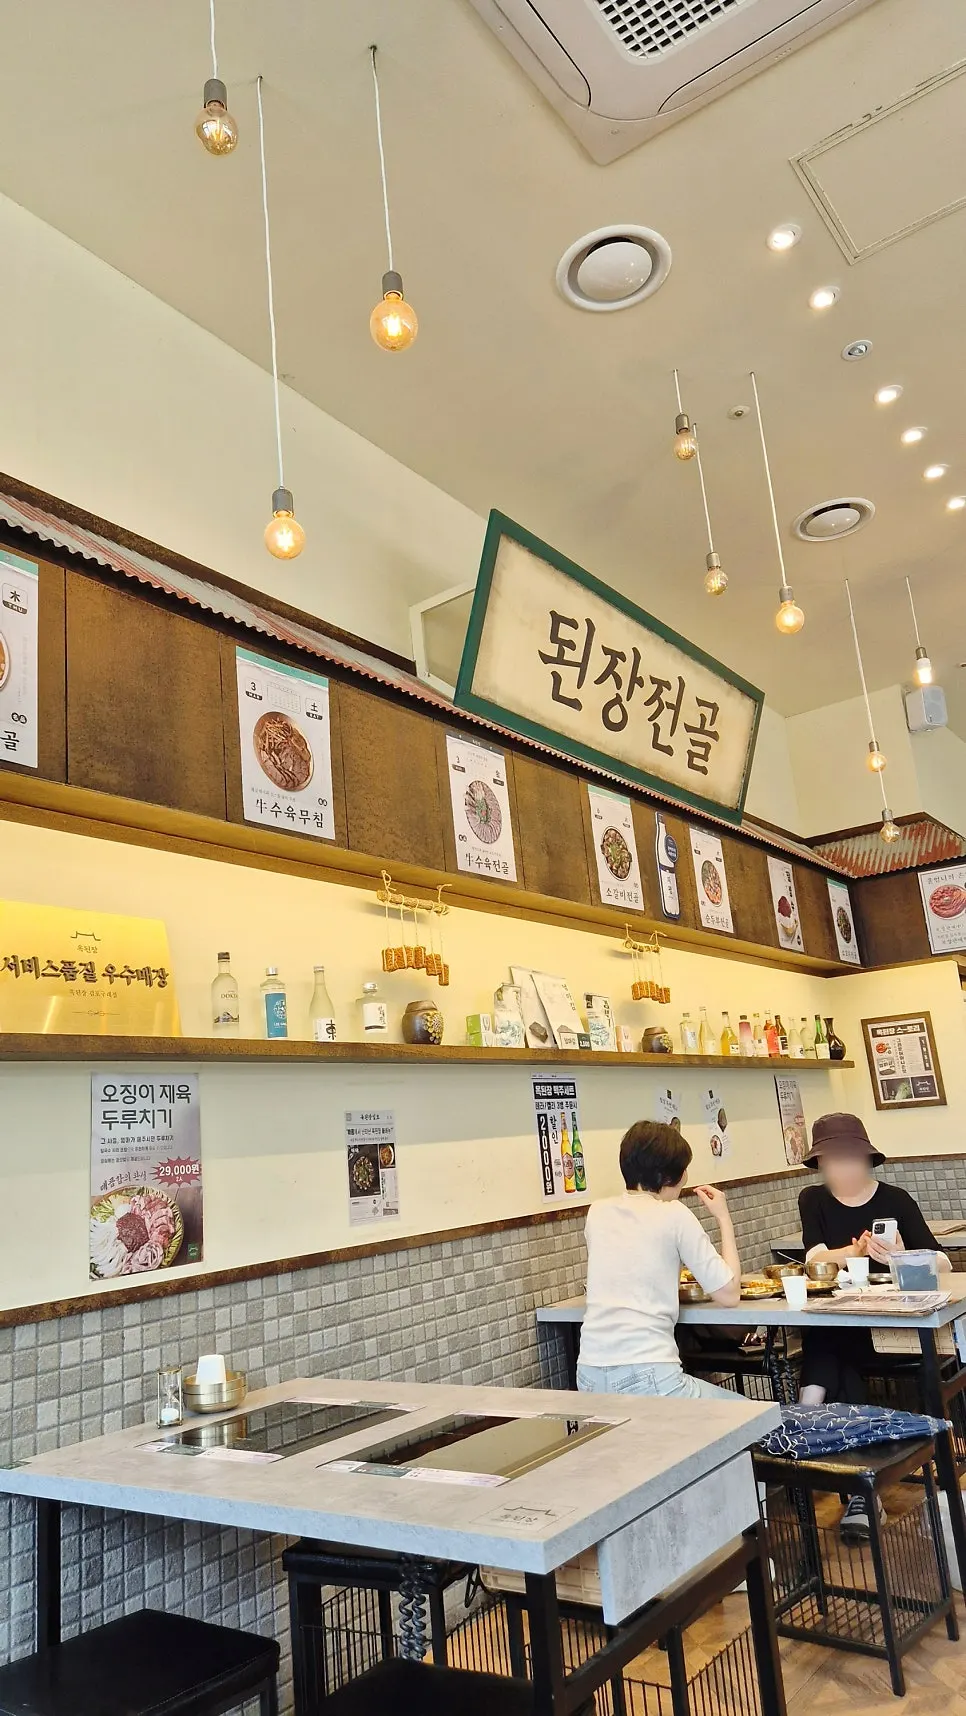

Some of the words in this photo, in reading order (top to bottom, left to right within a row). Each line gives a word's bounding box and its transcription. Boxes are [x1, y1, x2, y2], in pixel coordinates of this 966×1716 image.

[250, 682, 257, 691] 3
[538, 610, 720, 775] 된장전골
[0, 954, 98, 983] 서비스품질
[101, 963, 169, 988] 우수매장
[159, 1084, 191, 1104] 제육
[535, 1085, 552, 1097] 옥된장
[101, 1108, 172, 1131] 두루치기
[549, 1114, 559, 1145] 할인
[159, 1163, 200, 1177] 29,000원
